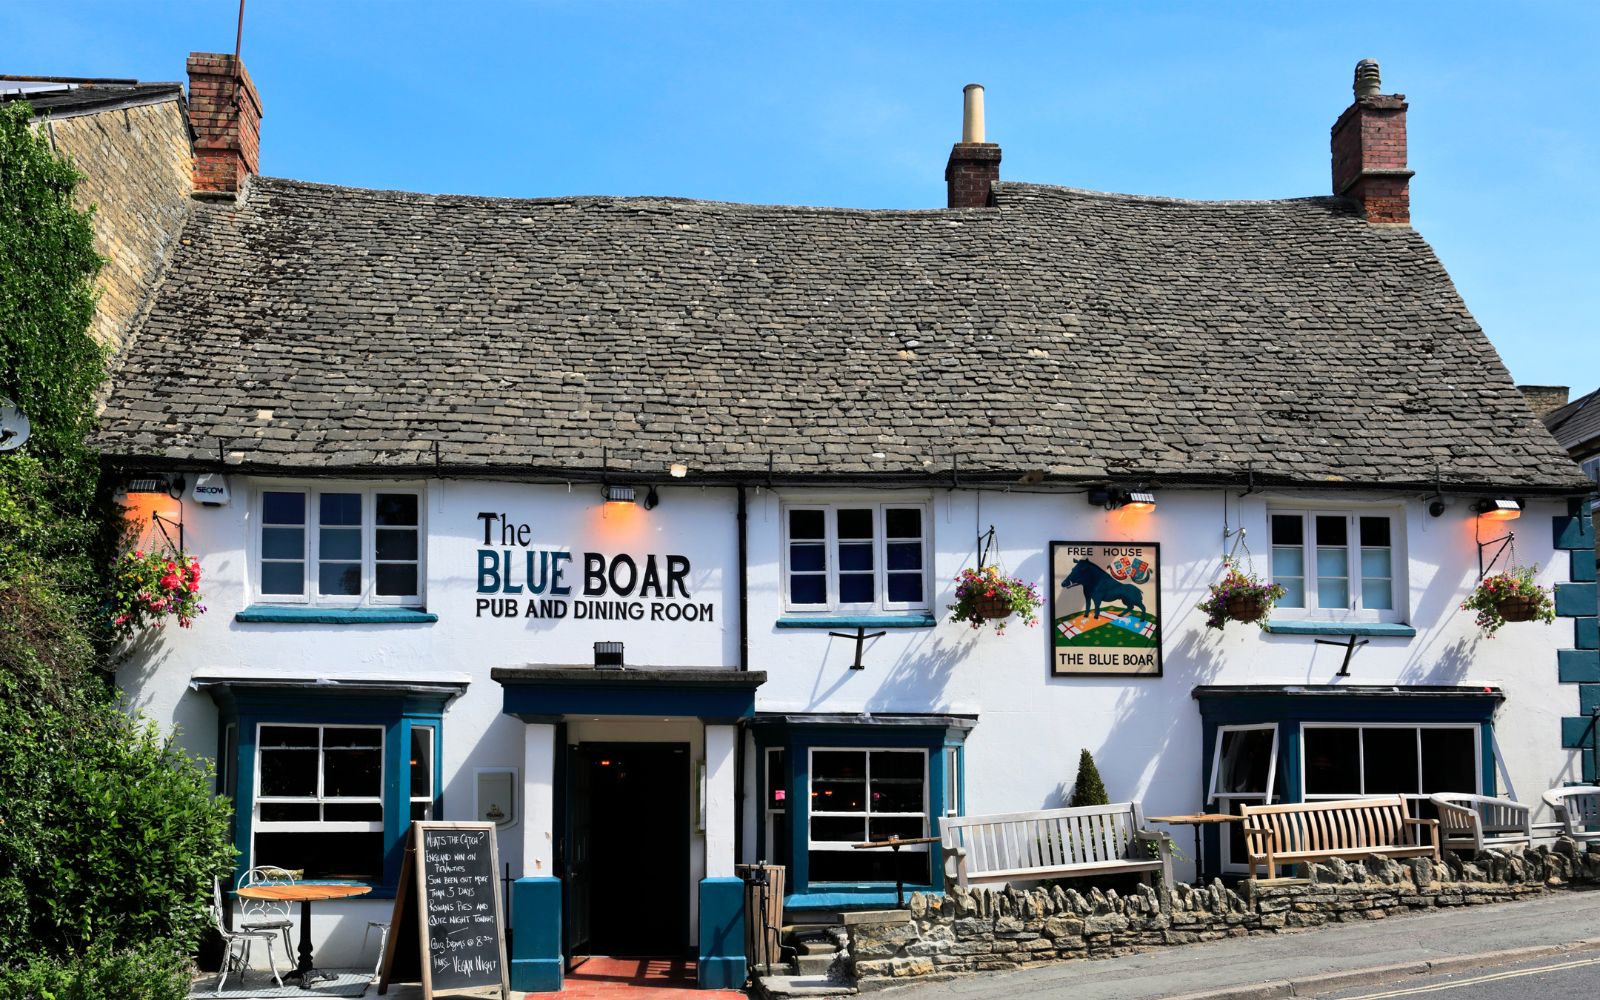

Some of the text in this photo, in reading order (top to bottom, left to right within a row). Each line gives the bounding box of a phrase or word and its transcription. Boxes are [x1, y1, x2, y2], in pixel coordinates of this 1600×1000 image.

[477, 512, 531, 546] The
[1067, 547, 1142, 556] FREE HOUSE
[476, 550, 691, 599] BLUE BOAR
[476, 599, 714, 622] PUB AND DINING ROOM
[1059, 653, 1154, 665] THE BLUE BOAR
[447, 836, 459, 844] THE
[454, 853, 465, 861] WIN
[467, 852, 476, 860] ON
[458, 888, 475, 896] DAYS
[477, 902, 488, 911] AND
[450, 916, 470, 924] NIGHT
